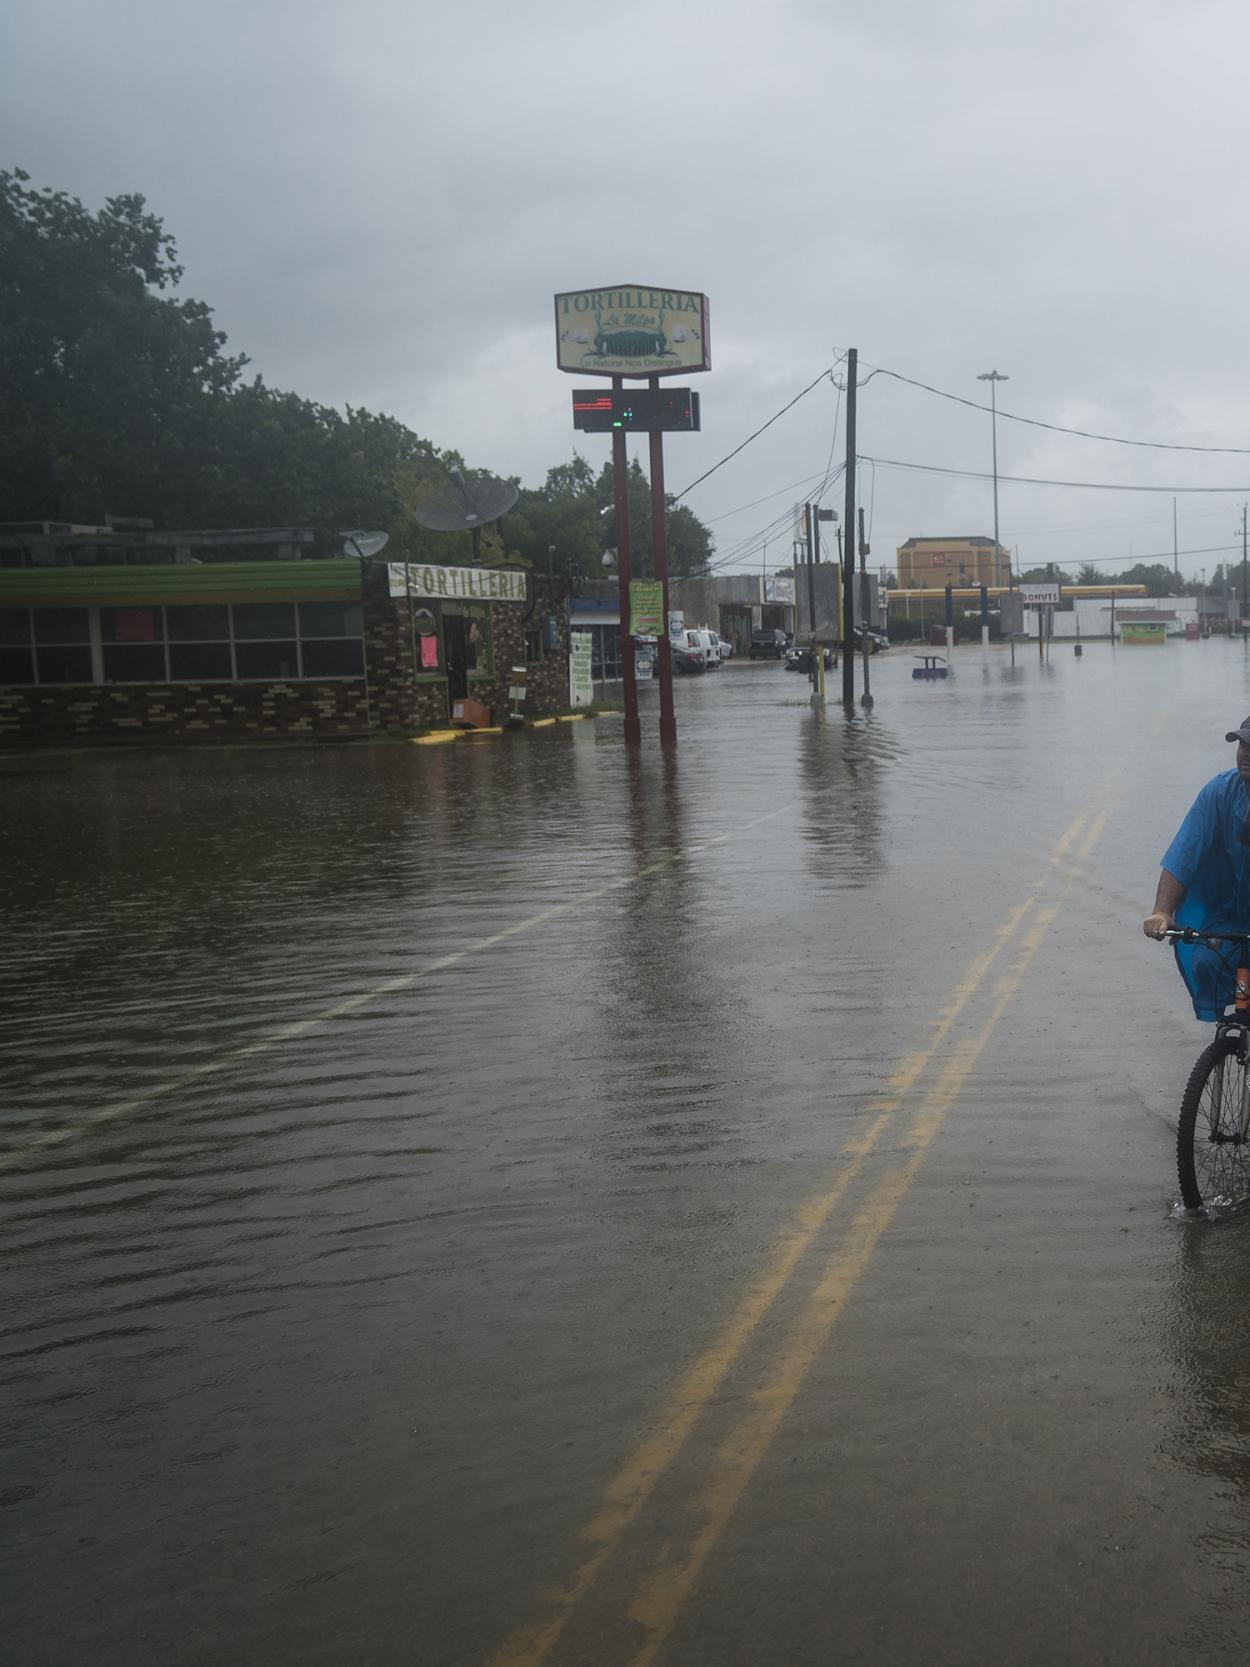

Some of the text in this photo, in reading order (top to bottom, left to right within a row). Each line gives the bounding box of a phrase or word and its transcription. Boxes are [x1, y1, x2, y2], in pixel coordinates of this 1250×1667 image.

[561, 290, 699, 313] TORTILLERIA
[593, 359, 623, 368] Natural
[625, 359, 642, 368] Nos
[644, 358, 682, 369] Distingue
[409, 566, 526, 598] TORTILLERIA
[1023, 592, 1058, 602] DONUTS
